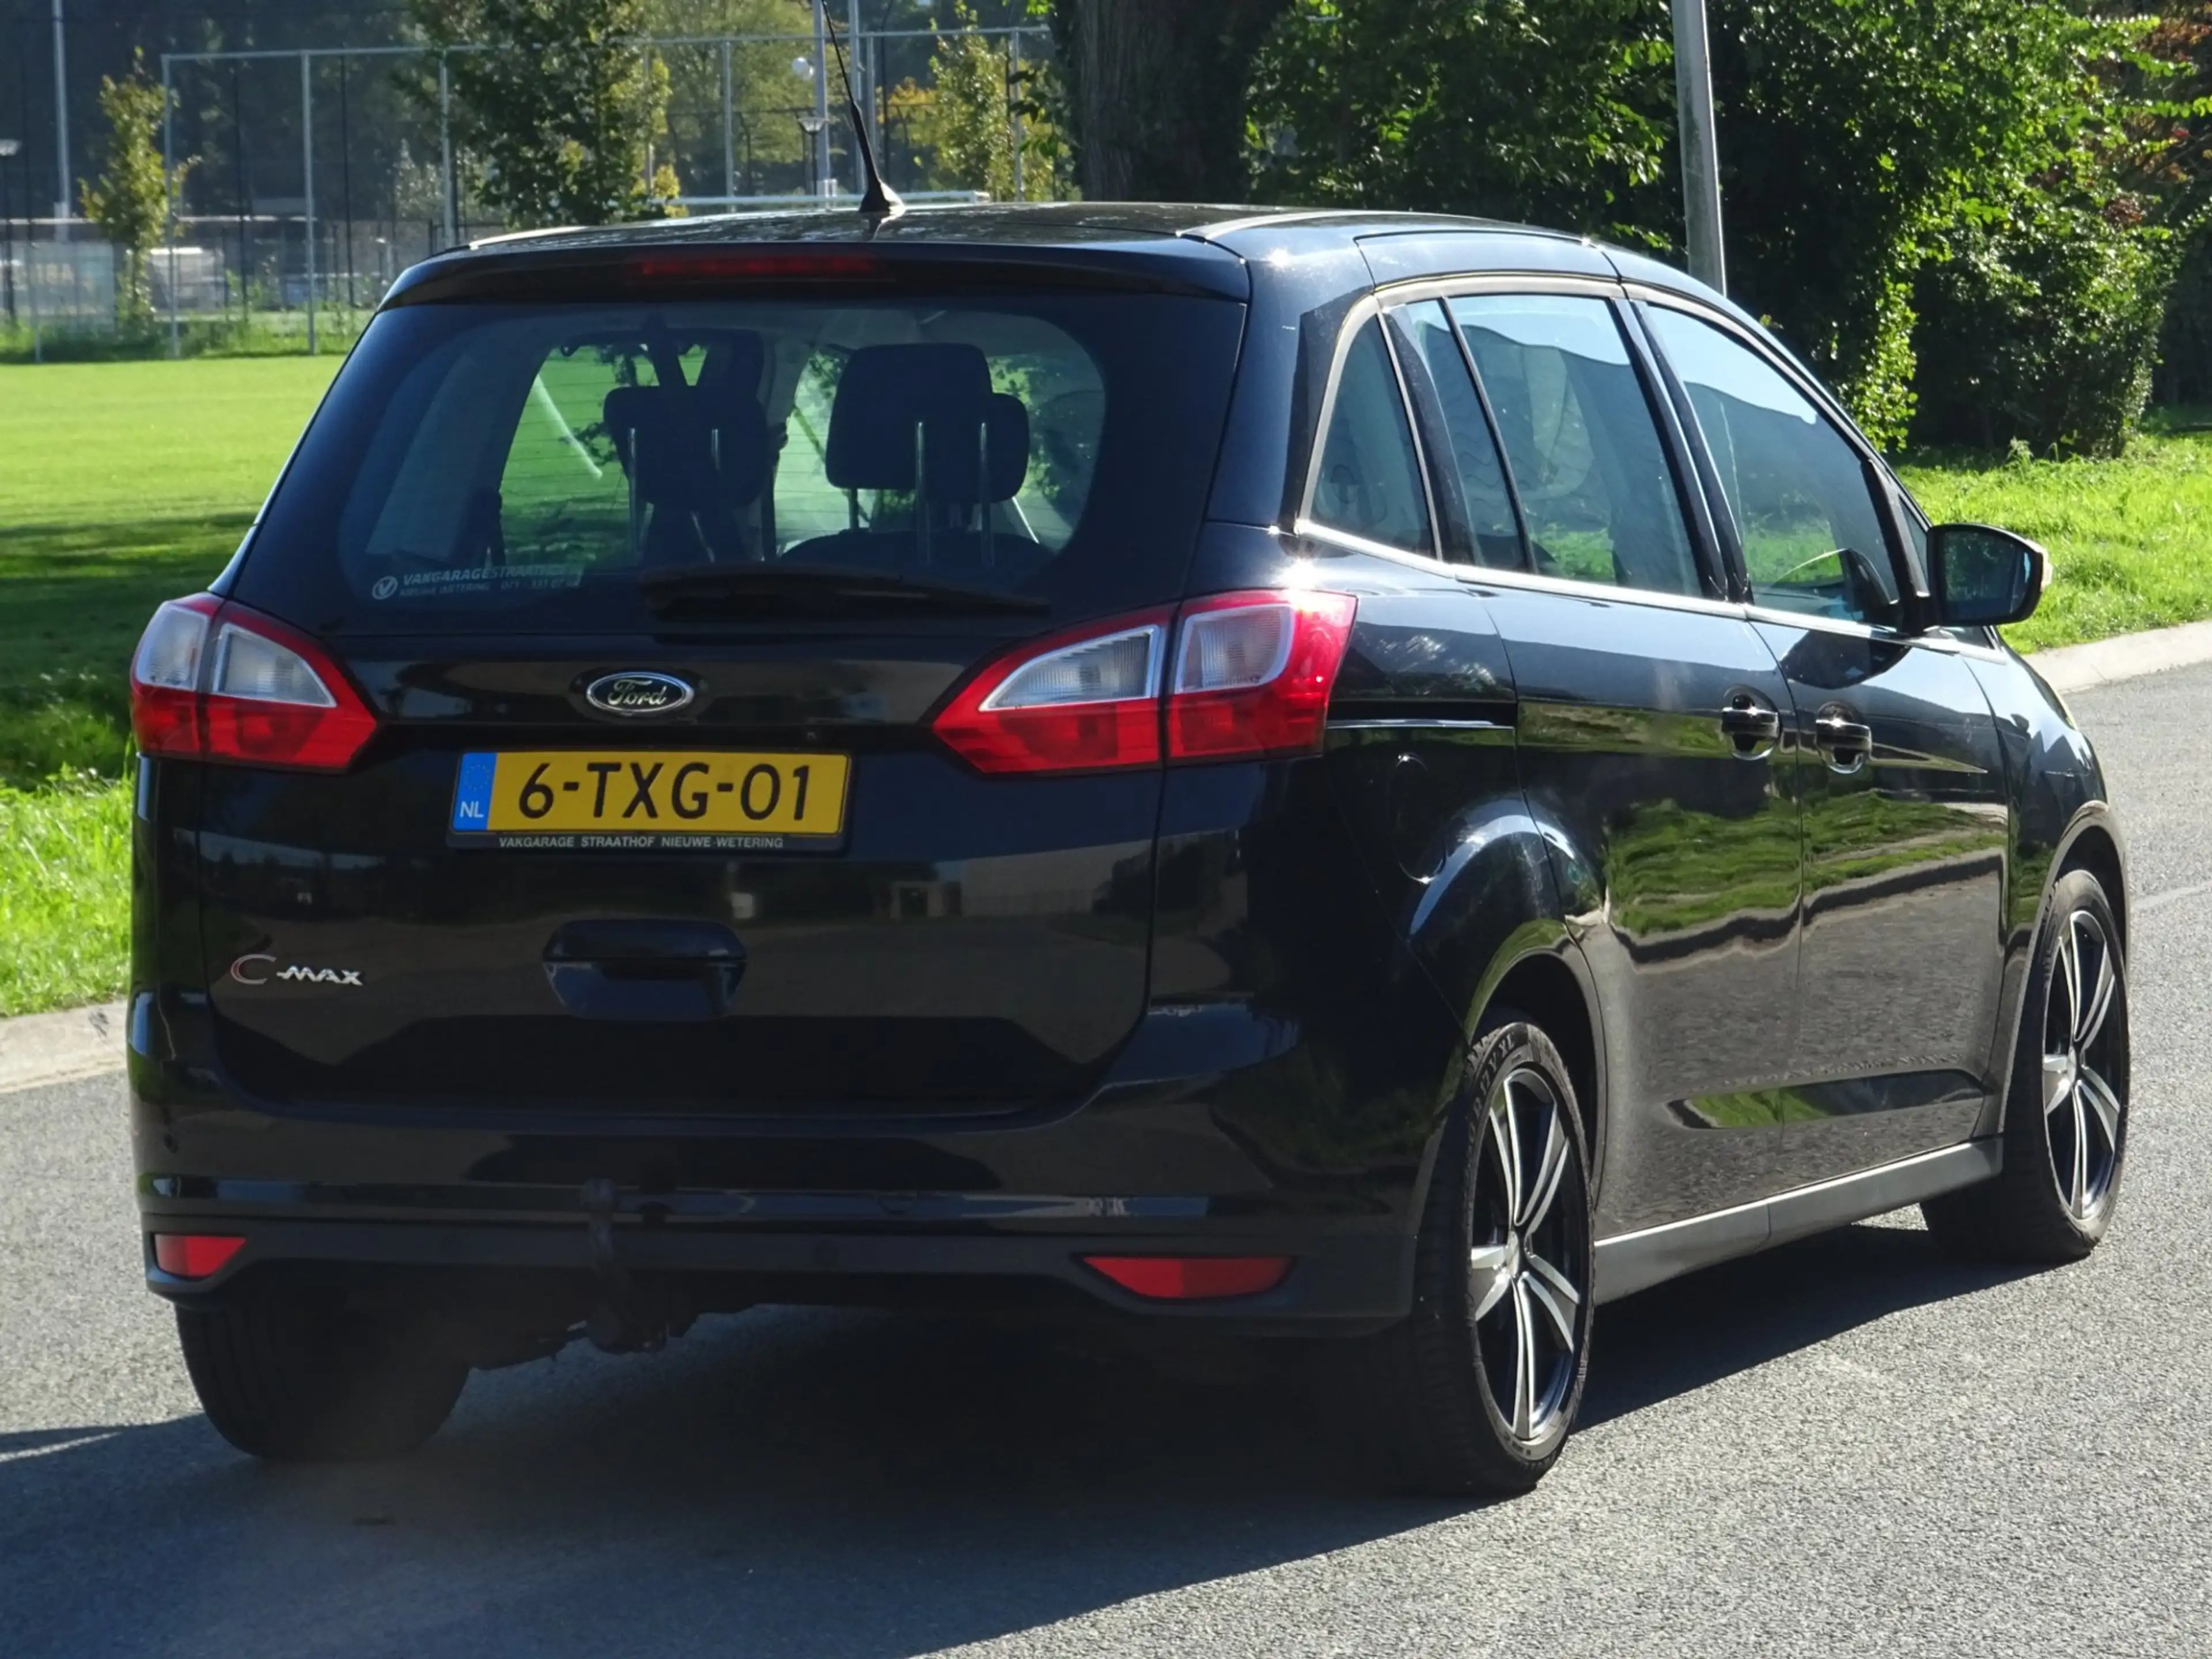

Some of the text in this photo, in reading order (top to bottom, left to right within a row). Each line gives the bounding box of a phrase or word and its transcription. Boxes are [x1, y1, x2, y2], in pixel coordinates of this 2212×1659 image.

[608, 679, 667, 706] Ford
[519, 763, 810, 821] 6-TXG-01
[460, 800, 484, 818] NL
[499, 836, 574, 848] VAKGARAGE
[581, 836, 655, 848] STRAATHOF
